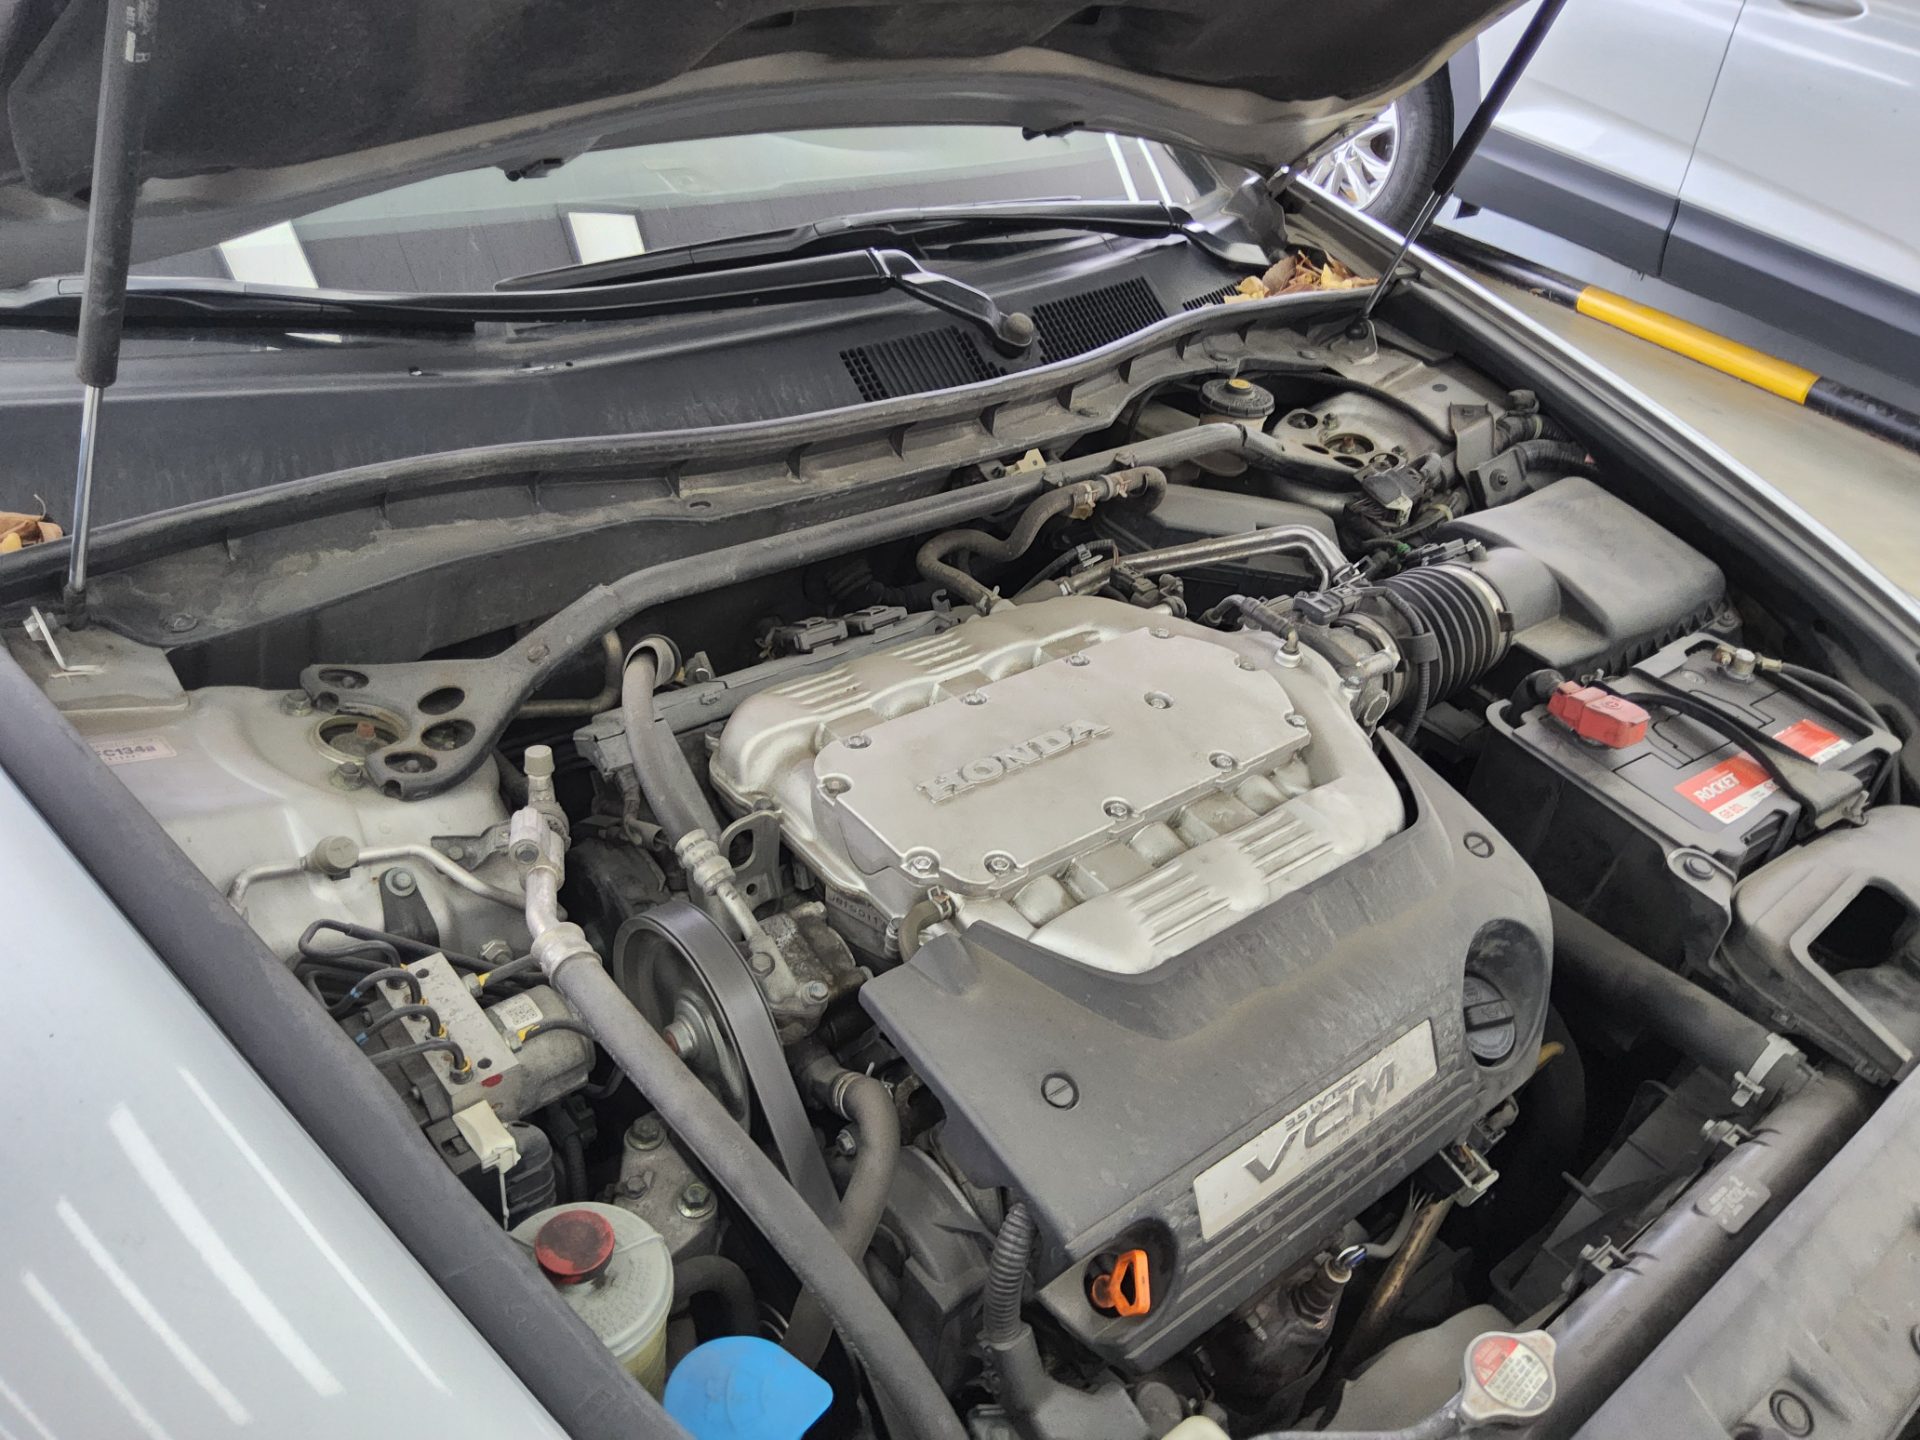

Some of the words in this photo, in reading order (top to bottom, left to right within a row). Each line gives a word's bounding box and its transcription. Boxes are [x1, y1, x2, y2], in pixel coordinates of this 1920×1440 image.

[916, 718, 1111, 804] HONDA
[1693, 772, 1741, 803] ROCKET
[1242, 1058, 1395, 1183] VCM
